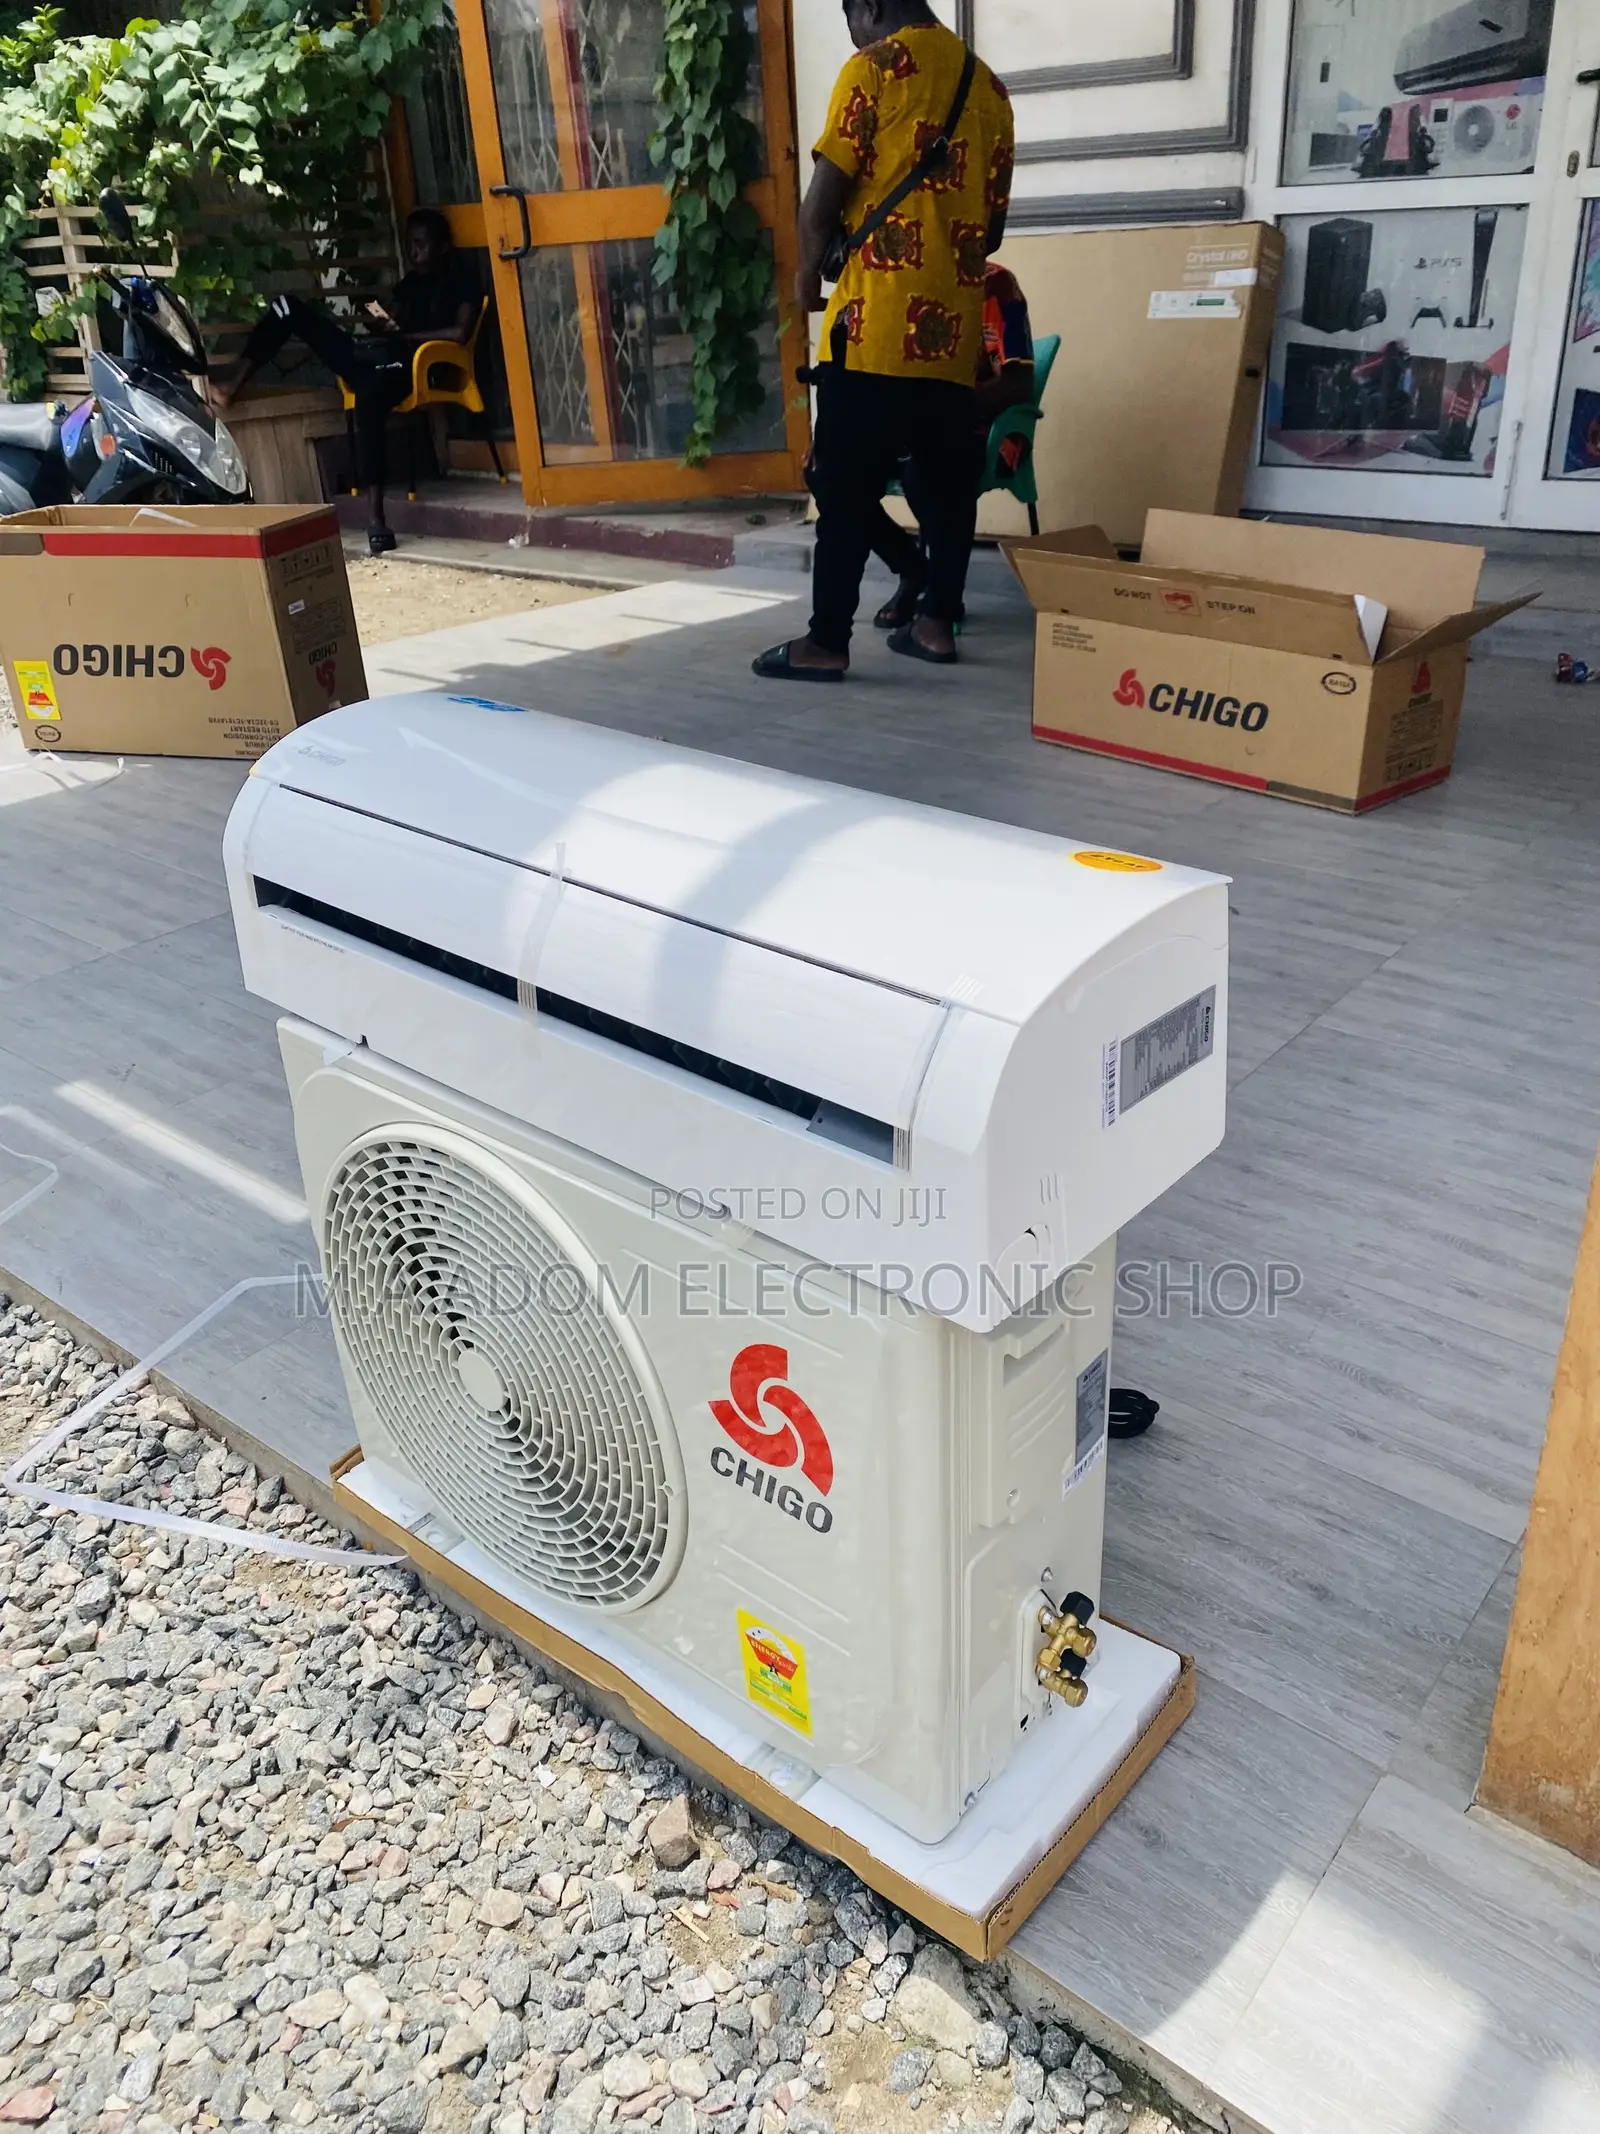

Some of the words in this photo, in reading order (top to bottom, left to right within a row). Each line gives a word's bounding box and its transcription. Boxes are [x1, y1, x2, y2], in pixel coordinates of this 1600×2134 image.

[53, 643, 184, 678] CHIGO
[1149, 683, 1269, 732] CHIGO
[230, 725, 261, 733] RESTART
[710, 1446, 833, 1533] CHIGO
